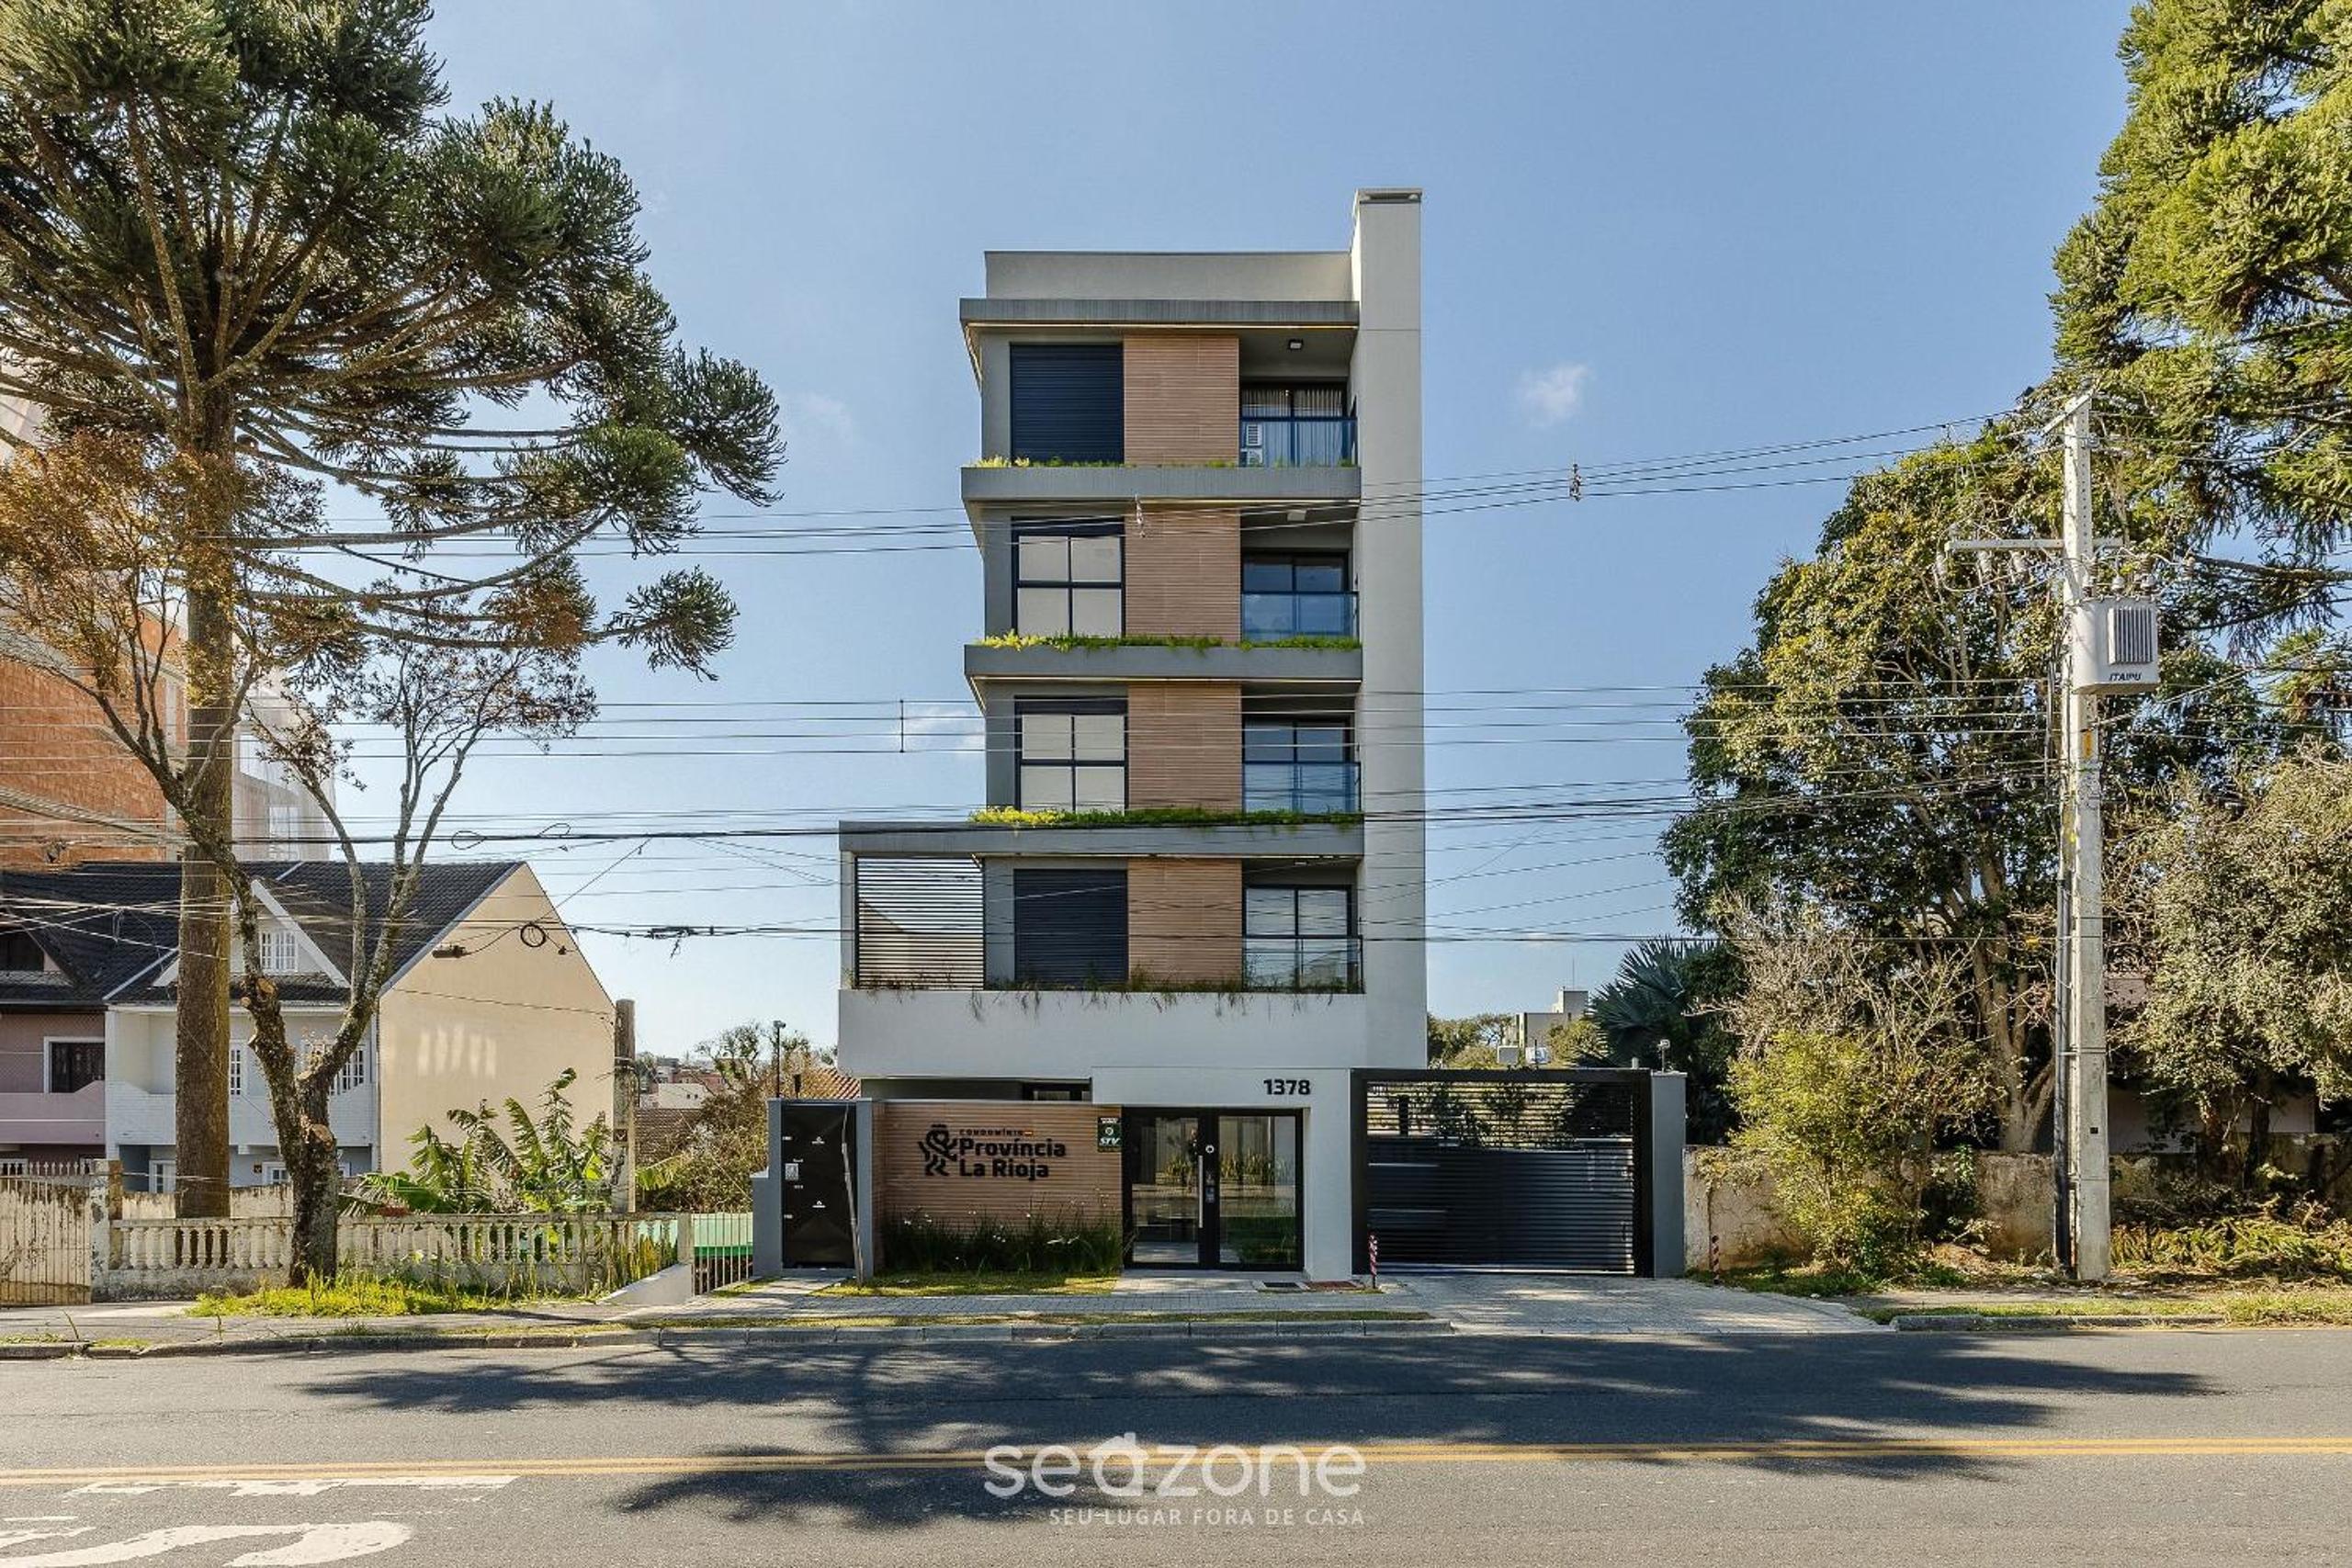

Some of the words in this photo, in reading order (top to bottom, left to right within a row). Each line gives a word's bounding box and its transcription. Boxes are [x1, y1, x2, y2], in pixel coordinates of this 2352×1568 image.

[2109, 671, 2142, 681] ITAIPU
[1263, 1079, 1311, 1095] 1378
[959, 1138, 1067, 1156] Província
[959, 1158, 986, 1177] La
[992, 1158, 1049, 1180] Rioja
